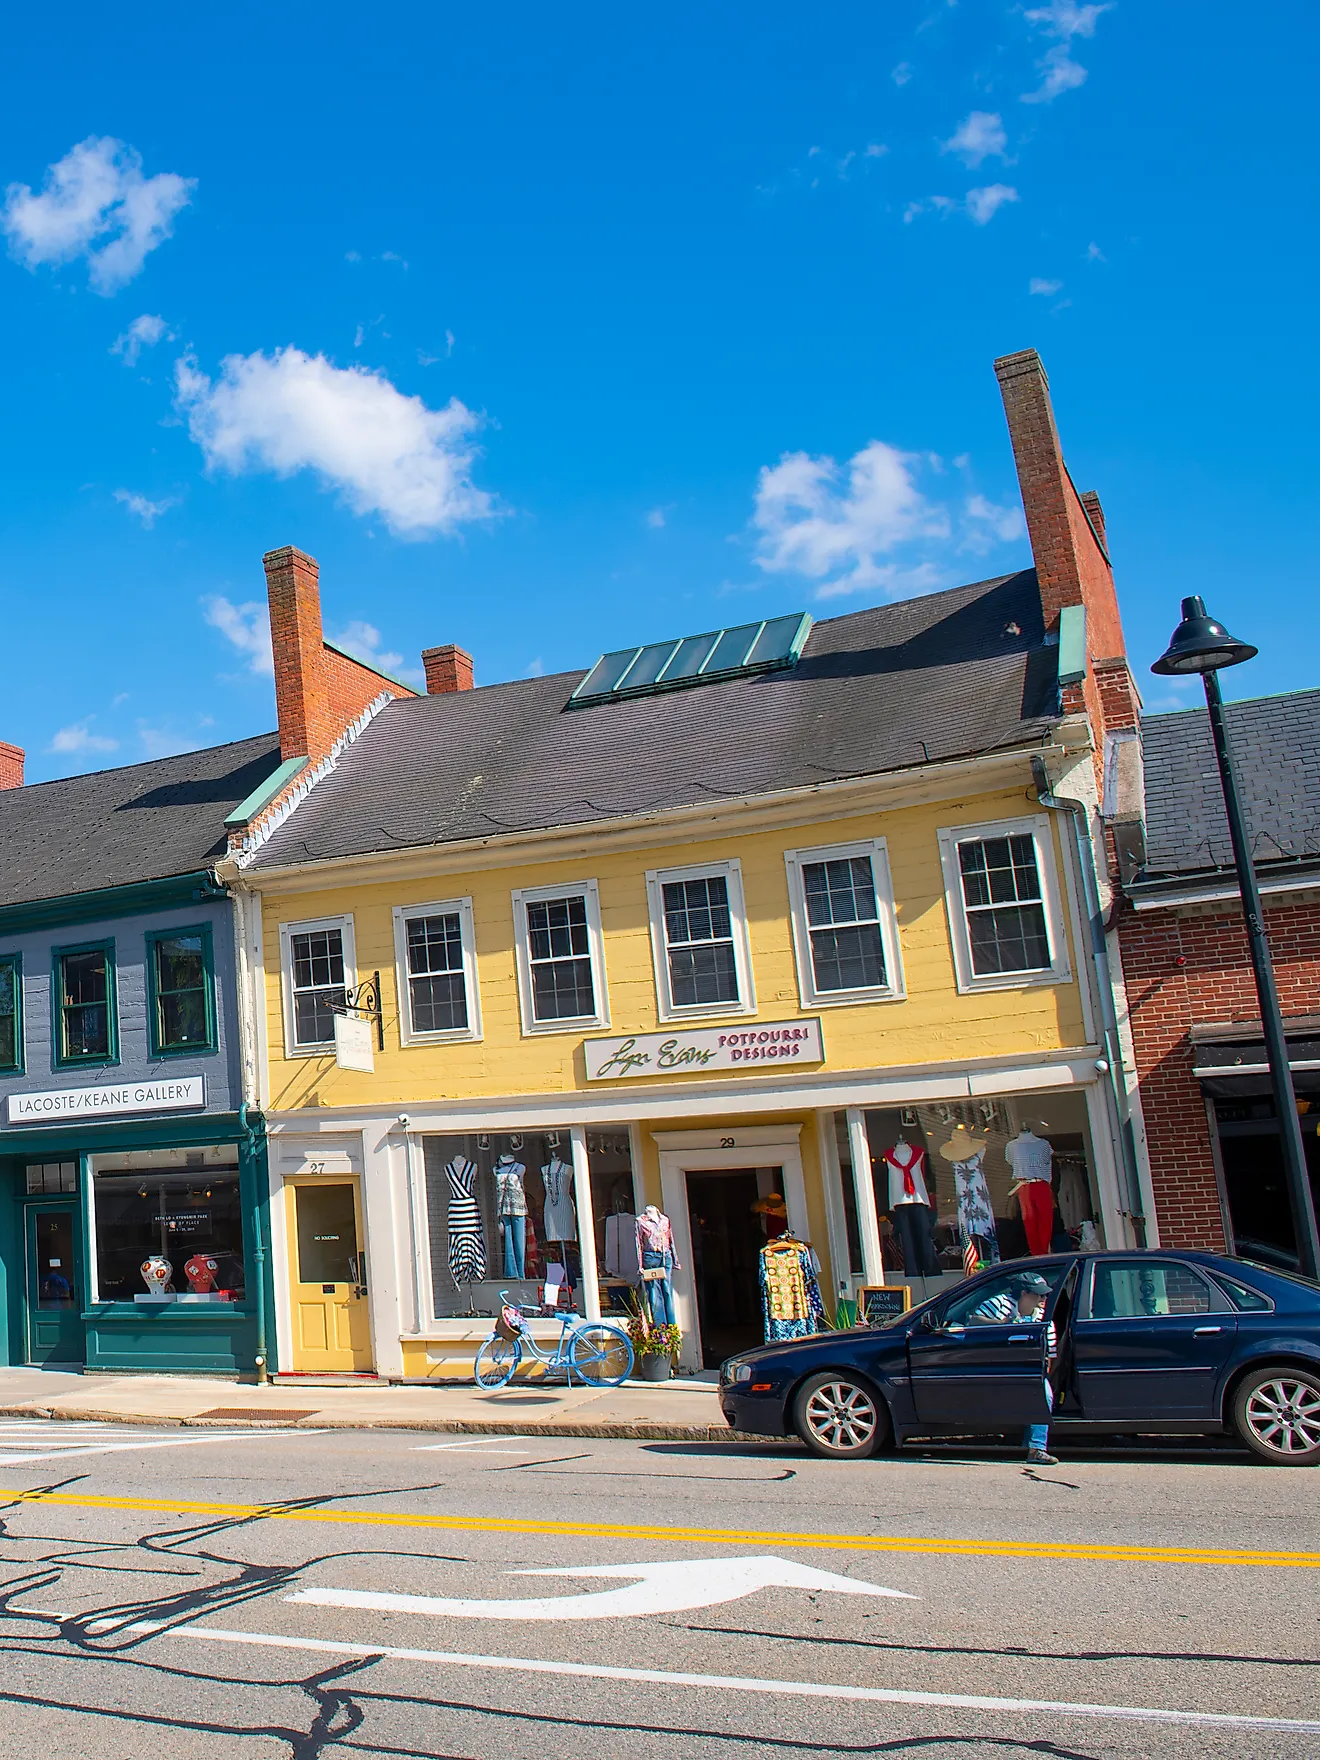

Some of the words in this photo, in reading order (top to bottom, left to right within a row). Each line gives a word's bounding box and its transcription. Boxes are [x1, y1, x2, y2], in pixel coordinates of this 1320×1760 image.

[718, 1028, 809, 1047] POTPOURRI
[657, 1039, 717, 1069] Evans
[731, 1044, 800, 1061] DESIGNS
[19, 1090, 129, 1113] LACOSTE/KEANE
[134, 1084, 192, 1102] GALLERY
[720, 1137, 735, 1148] 29
[310, 1162, 325, 1175] 27
[872, 1293, 891, 1301] NEW
